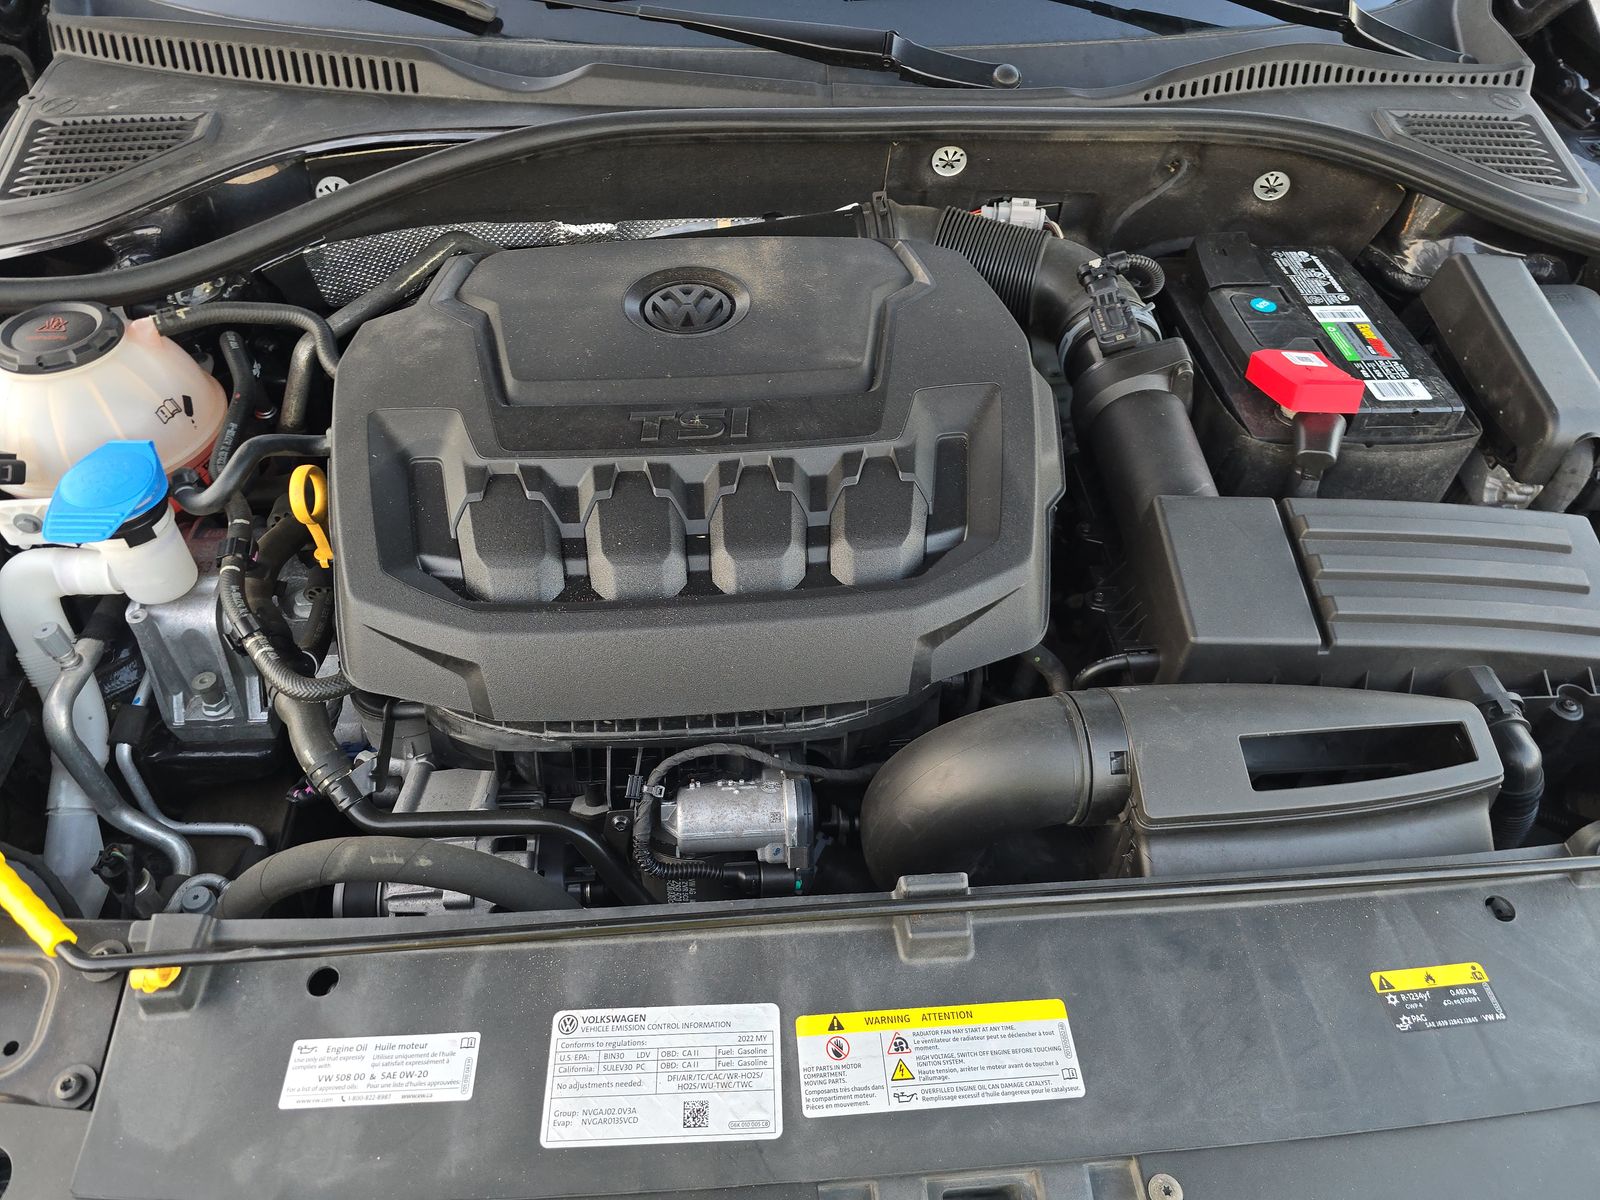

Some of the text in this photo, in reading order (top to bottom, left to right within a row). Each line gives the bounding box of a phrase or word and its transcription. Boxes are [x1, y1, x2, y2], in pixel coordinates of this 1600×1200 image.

[630, 407, 750, 441] TSI
[1400, 990, 1431, 1002] R-1234yf
[582, 1014, 646, 1024] VOLKSWAGEN
[864, 1010, 973, 1026] WARNING ATTENTION
[1411, 1014, 1428, 1023] PAG
[611, 1024, 646, 1032] EMISSION
[647, 1022, 680, 1031] CONTROL
[681, 1021, 732, 1029] INFORMATION
[560, 1041, 595, 1049] Conforms
[605, 1039, 647, 1048] regulations:
[738, 1035, 754, 1043] 2022
[326, 1043, 368, 1055] Engine Oil
[374, 1042, 428, 1051] Huile moteur
[737, 1047, 768, 1055] Gasoline
[394, 1052, 430, 1060] uniquement
[405, 1058, 445, 1066] expressément
[660, 1062, 679, 1070] OBD:
[717, 1058, 768, 1068] Fuel: Gasoline
[558, 1065, 595, 1074] California:
[602, 1063, 645, 1072] SULEV30 PC
[335, 1073, 352, 1082] 508
[353, 1072, 366, 1081] 00
[380, 1071, 397, 1080] SAE
[399, 1070, 429, 1079] 0W-20
[803, 1070, 848, 1080] COMPARTMENT.
[568, 1081, 614, 1091] adjustments
[920, 1086, 955, 1095] OVERFILLED
[1024, 1079, 1053, 1087] CATALYST.
[958, 1092, 980, 1100] excessif
[1050, 1085, 1081, 1093] catalyseur.
[811, 1094, 853, 1103] compartiment
[554, 1110, 579, 1118] Group:
[553, 1119, 573, 1128] Evap:
